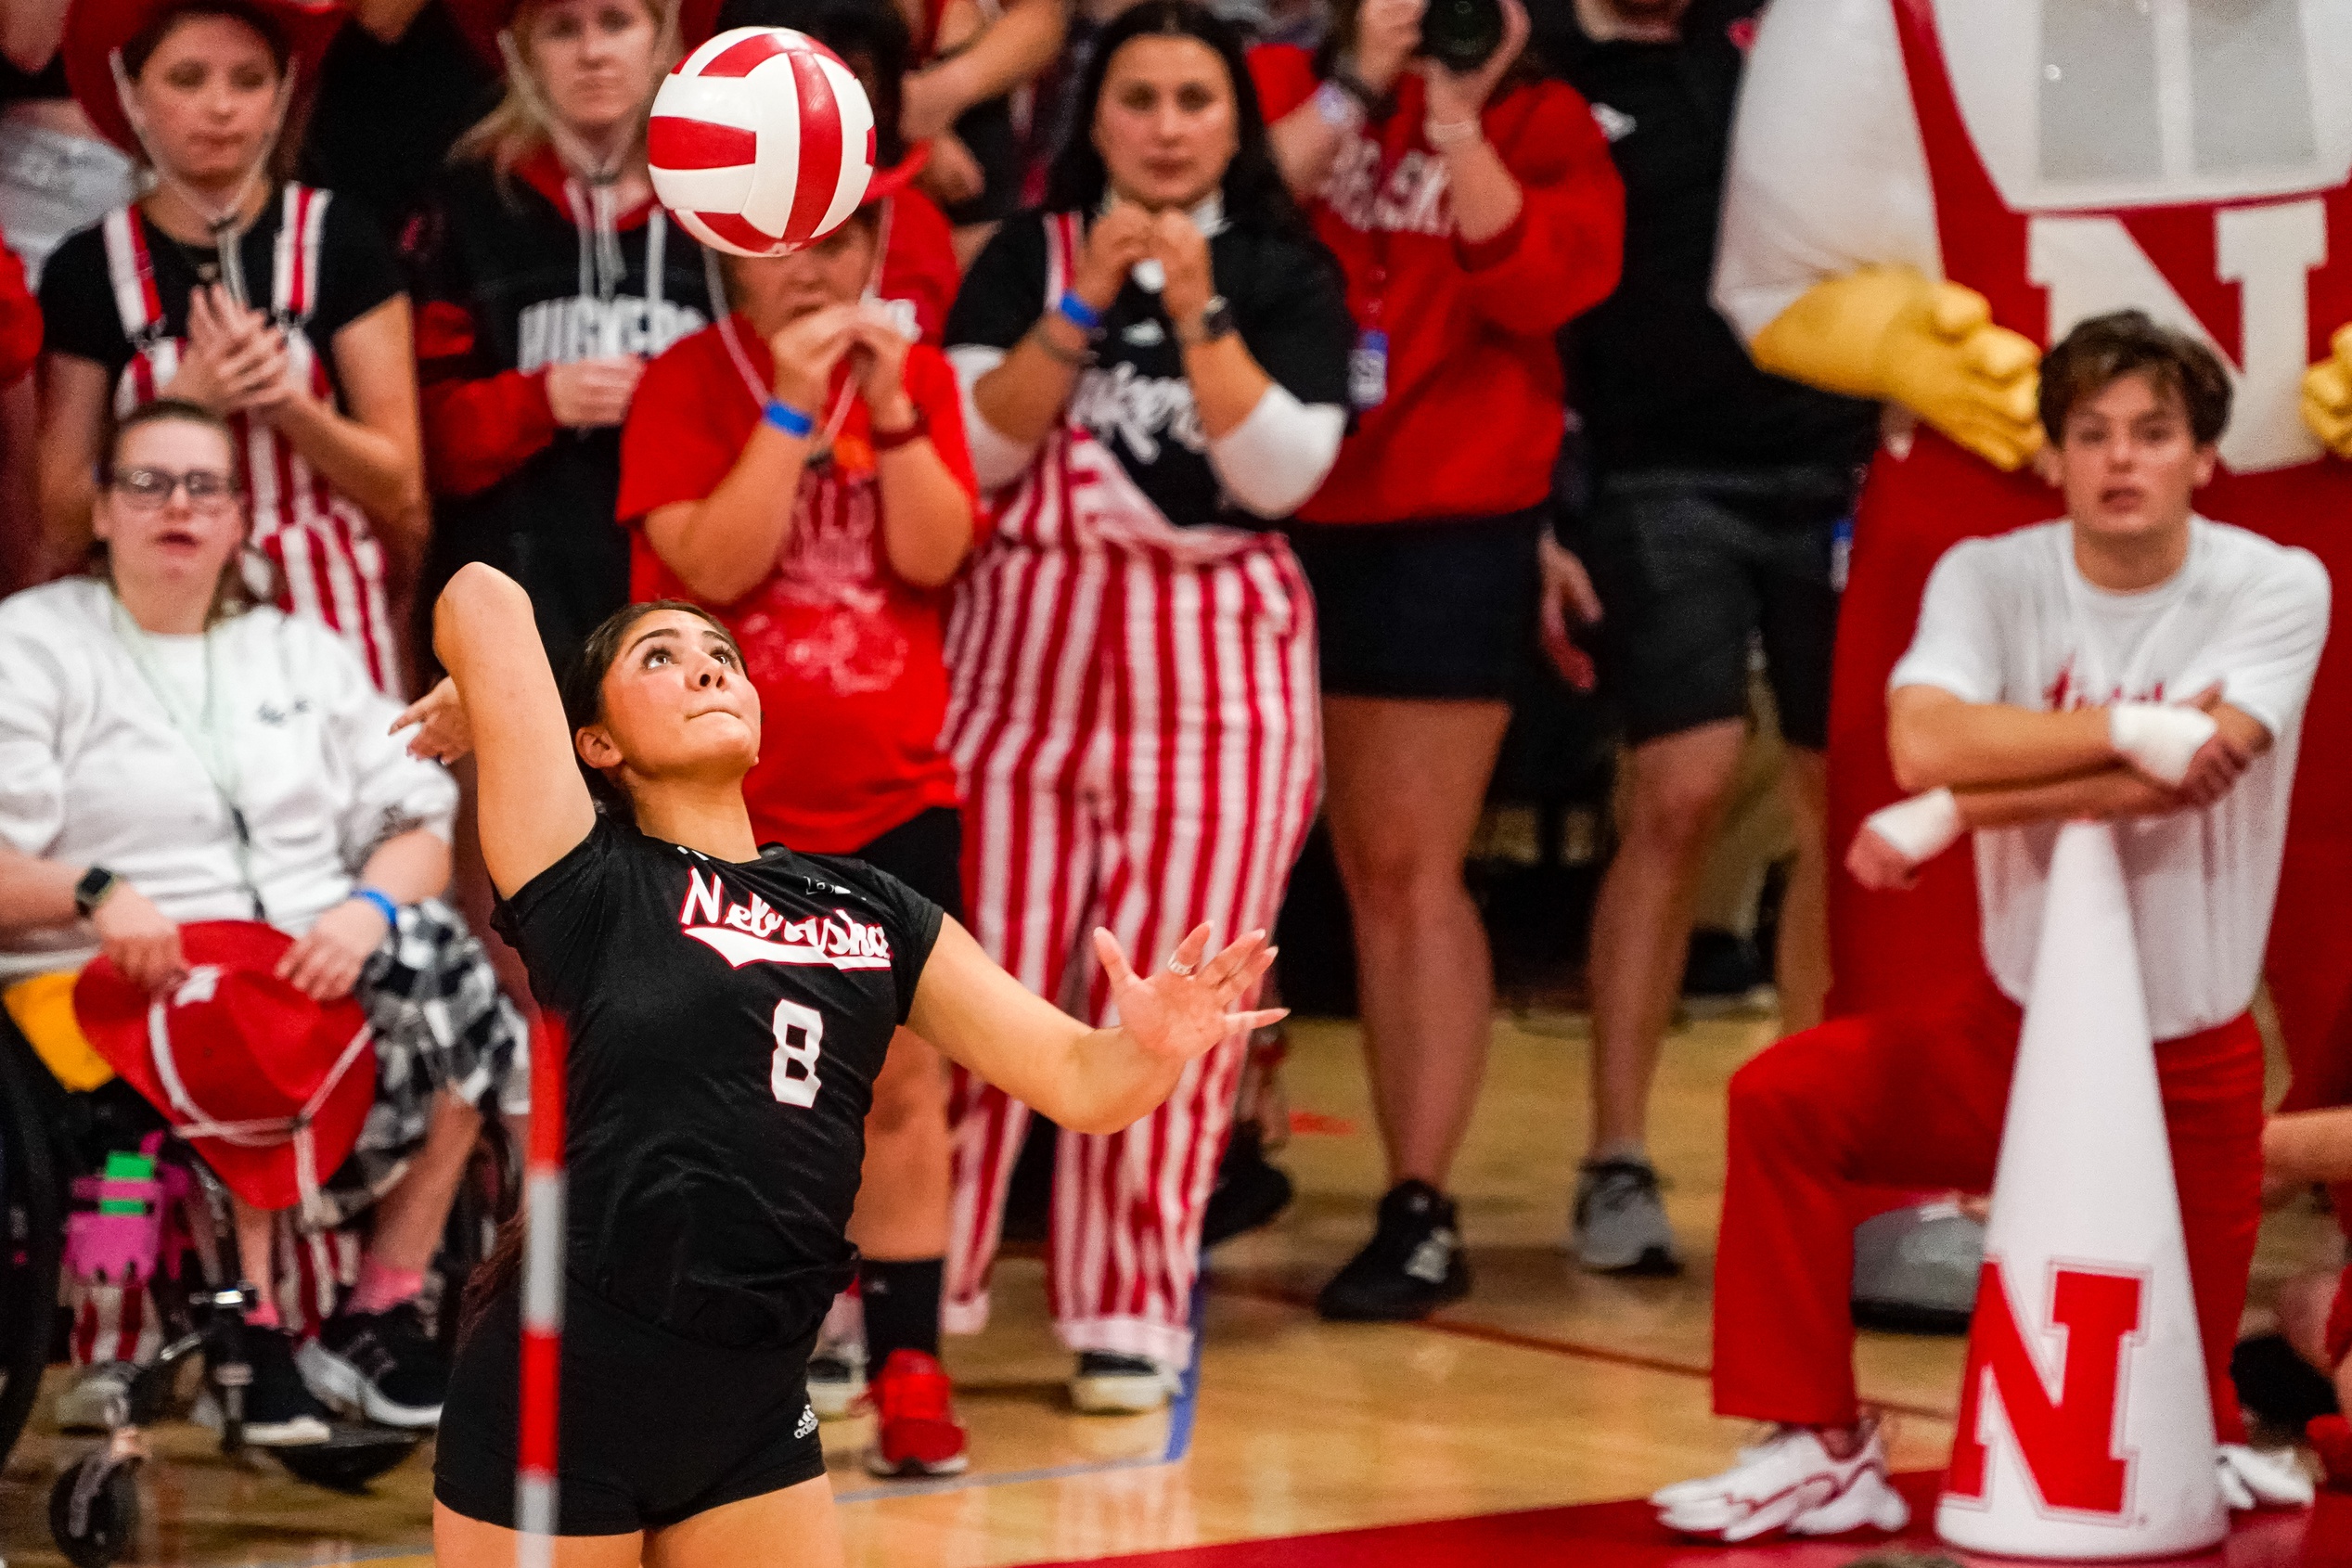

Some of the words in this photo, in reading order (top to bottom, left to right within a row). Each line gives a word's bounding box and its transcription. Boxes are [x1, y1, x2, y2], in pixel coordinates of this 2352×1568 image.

[2025, 193, 2329, 477] N
[770, 997, 824, 1109] 8
[1941, 1254, 2153, 1529] N
